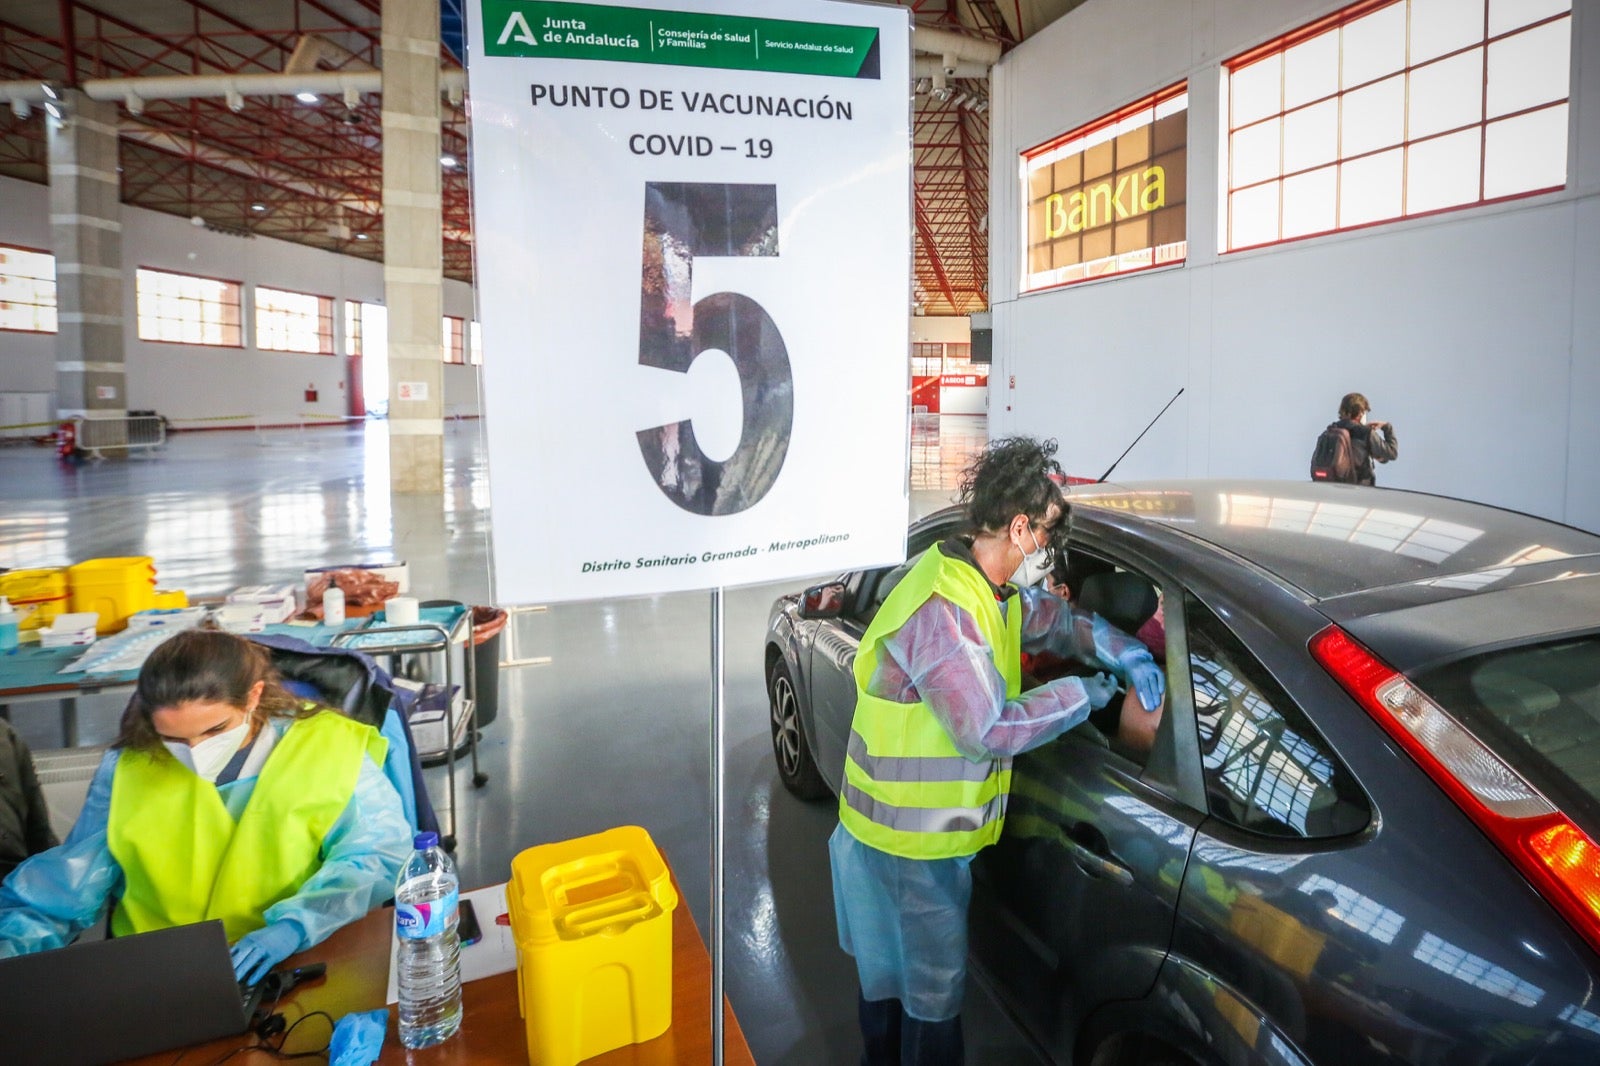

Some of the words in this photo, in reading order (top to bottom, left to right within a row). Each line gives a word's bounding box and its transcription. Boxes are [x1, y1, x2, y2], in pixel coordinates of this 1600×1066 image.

[543, 17, 586, 30] Junta
[543, 31, 563, 43] de
[565, 32, 640, 48] Andalucía
[658, 28, 709, 40] Consejería
[710, 31, 723, 41] de
[724, 33, 750, 43] Salud
[658, 38, 666, 48] y
[667, 38, 706, 49] Familias
[765, 40, 793, 49] Servicio
[794, 43, 822, 52] Andaluz
[823, 44, 833, 52] de
[833, 45, 854, 54] Salud
[530, 83, 631, 109] PUNTO
[639, 89, 675, 111] DE
[681, 91, 854, 121] VACUNACIÓN
[628, 134, 714, 157] COVID
[744, 138, 773, 158] 19
[1045, 165, 1166, 240] Bankia
[635, 180, 794, 517] 5
[581, 559, 631, 573] Distrito
[635, 553, 697, 569] Sanitario
[701, 545, 758, 563] Granada
[768, 532, 850, 554] Metropolitano
